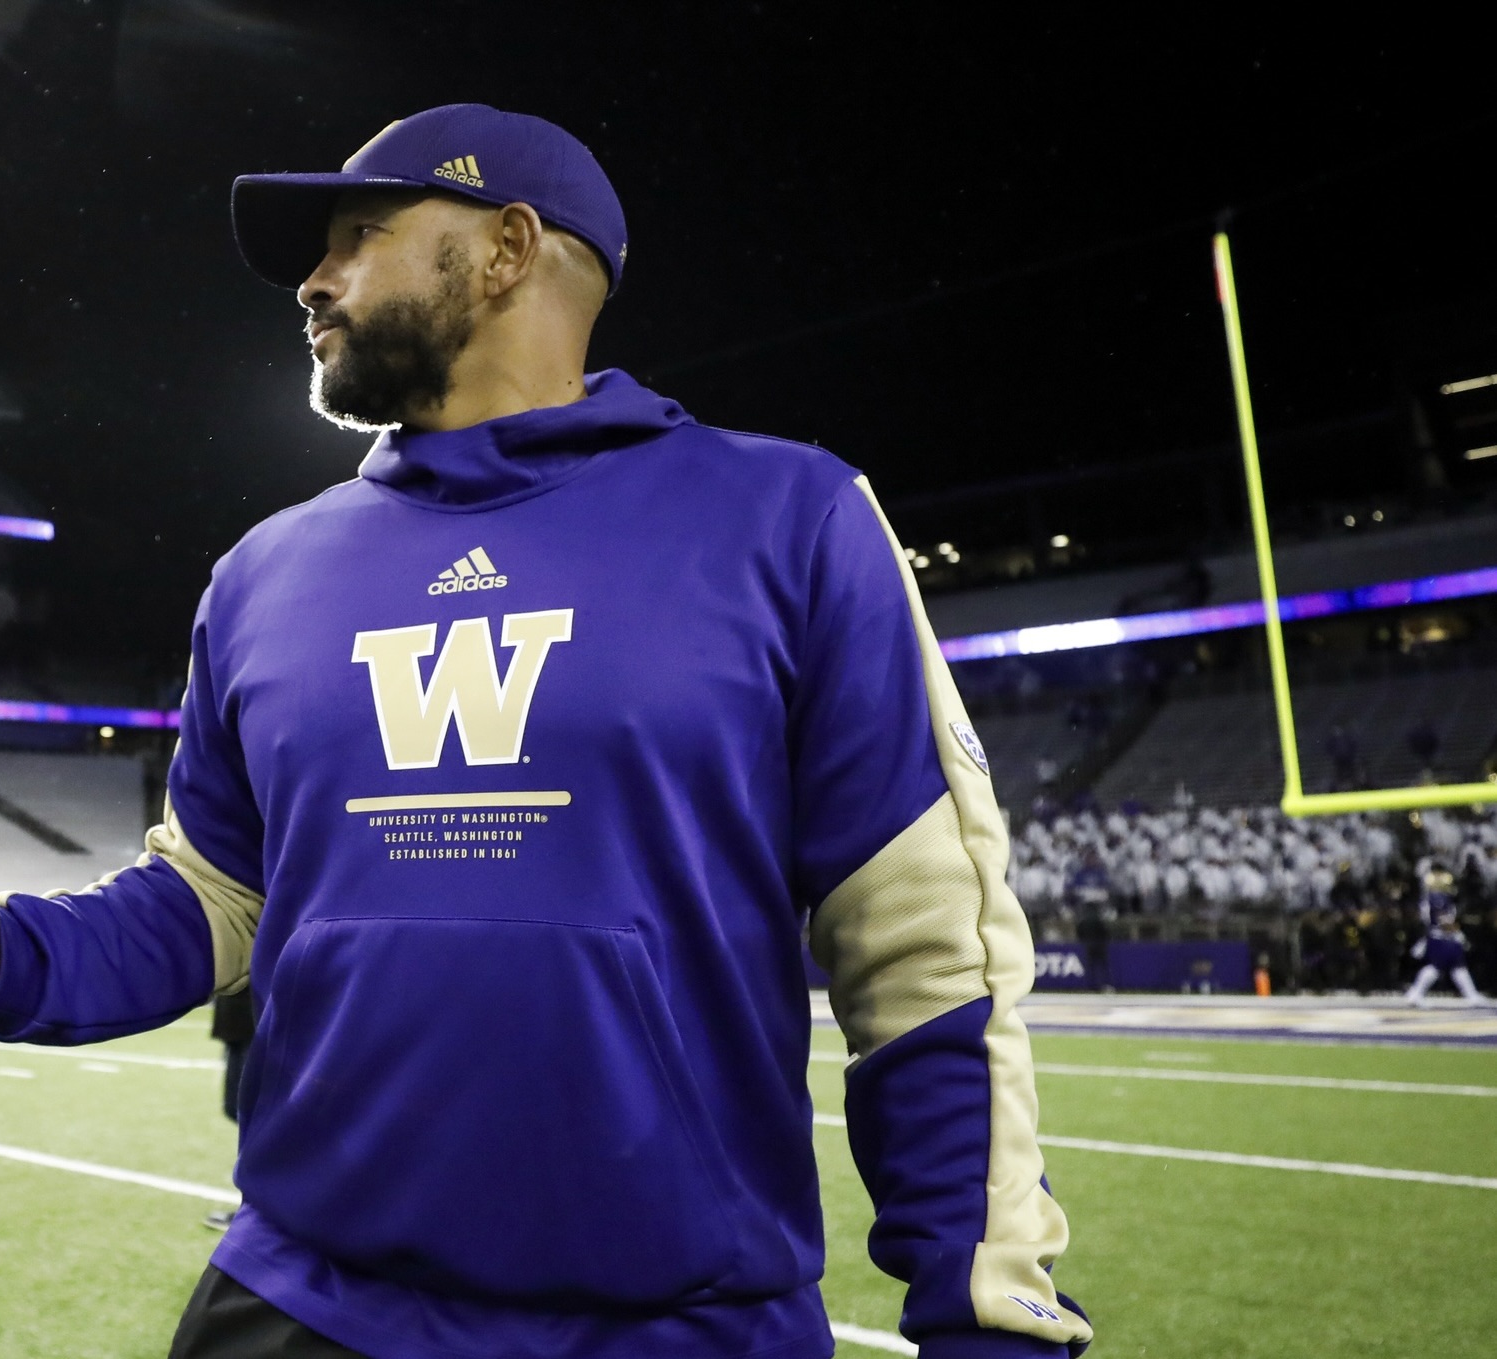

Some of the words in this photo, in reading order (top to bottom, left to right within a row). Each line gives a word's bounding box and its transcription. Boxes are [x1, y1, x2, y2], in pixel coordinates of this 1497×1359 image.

[433, 167, 485, 189] adidas
[427, 574, 508, 595] adidas
[351, 608, 574, 770] W
[369, 813, 437, 827] UNIVERSITY
[442, 813, 457, 824] OF
[443, 831, 523, 842] WASHINGTON
[389, 848, 468, 860] ESTABLISHED
[473, 848, 485, 859] IN
[490, 848, 517, 859] 1861
